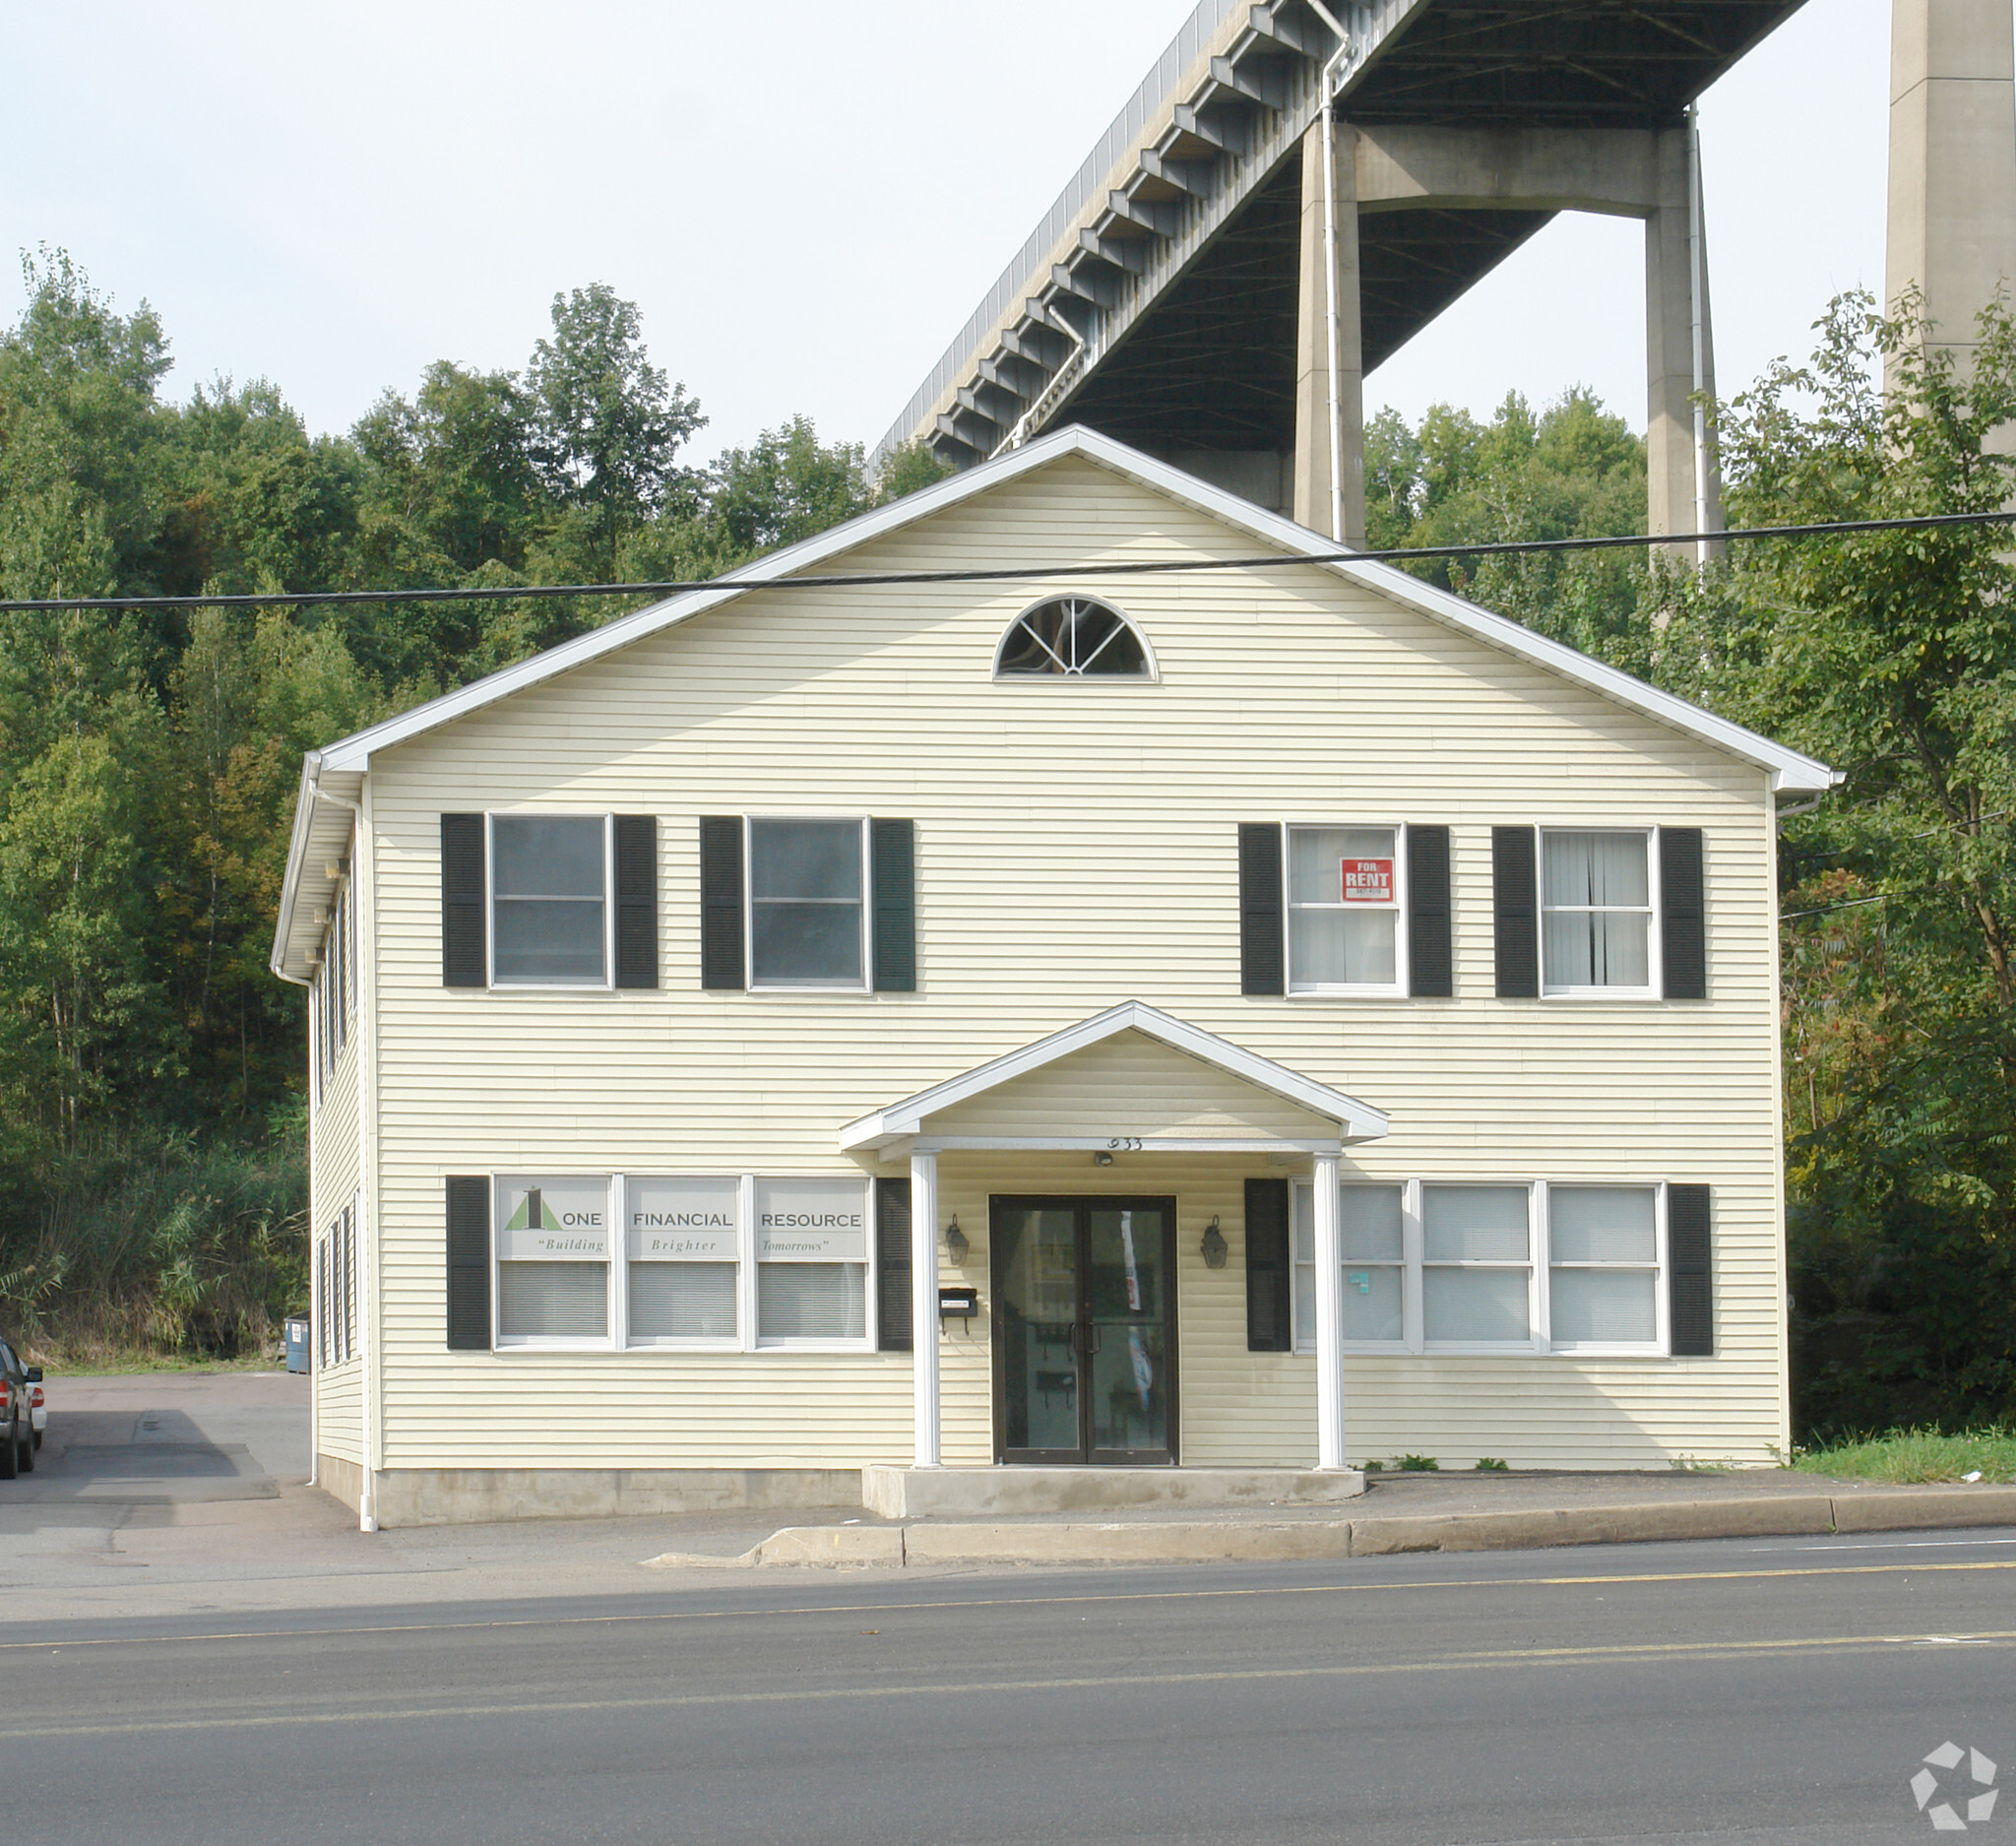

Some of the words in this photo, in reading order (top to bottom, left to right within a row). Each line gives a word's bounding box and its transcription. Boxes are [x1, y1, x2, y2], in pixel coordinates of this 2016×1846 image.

[1357, 862, 1377, 871] FOR
[1346, 872, 1389, 887] RENT
[562, 1212, 602, 1227] ONE
[633, 1213, 734, 1227] FINANCIAL
[761, 1213, 862, 1228] RESOURCE
[652, 1239, 717, 1253] Brighter
